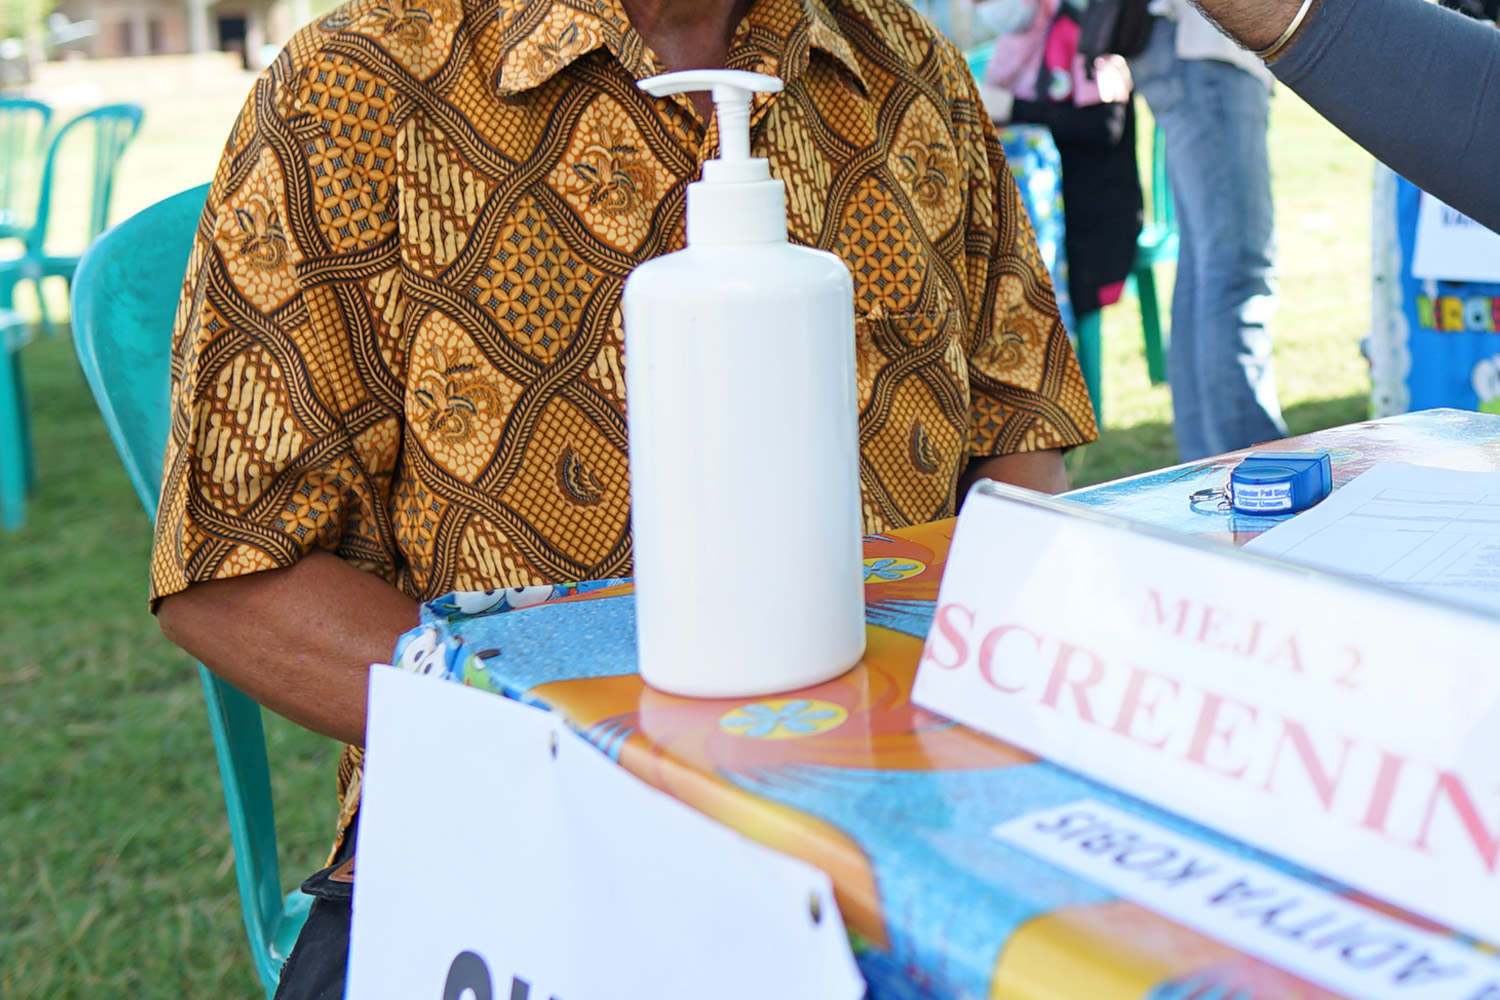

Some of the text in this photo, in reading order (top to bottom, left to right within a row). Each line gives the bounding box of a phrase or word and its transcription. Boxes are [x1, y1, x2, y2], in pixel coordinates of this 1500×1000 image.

[1136, 588, 1367, 692] MEJA 2
[1032, 807, 1469, 986] ADITYA KOBIS
